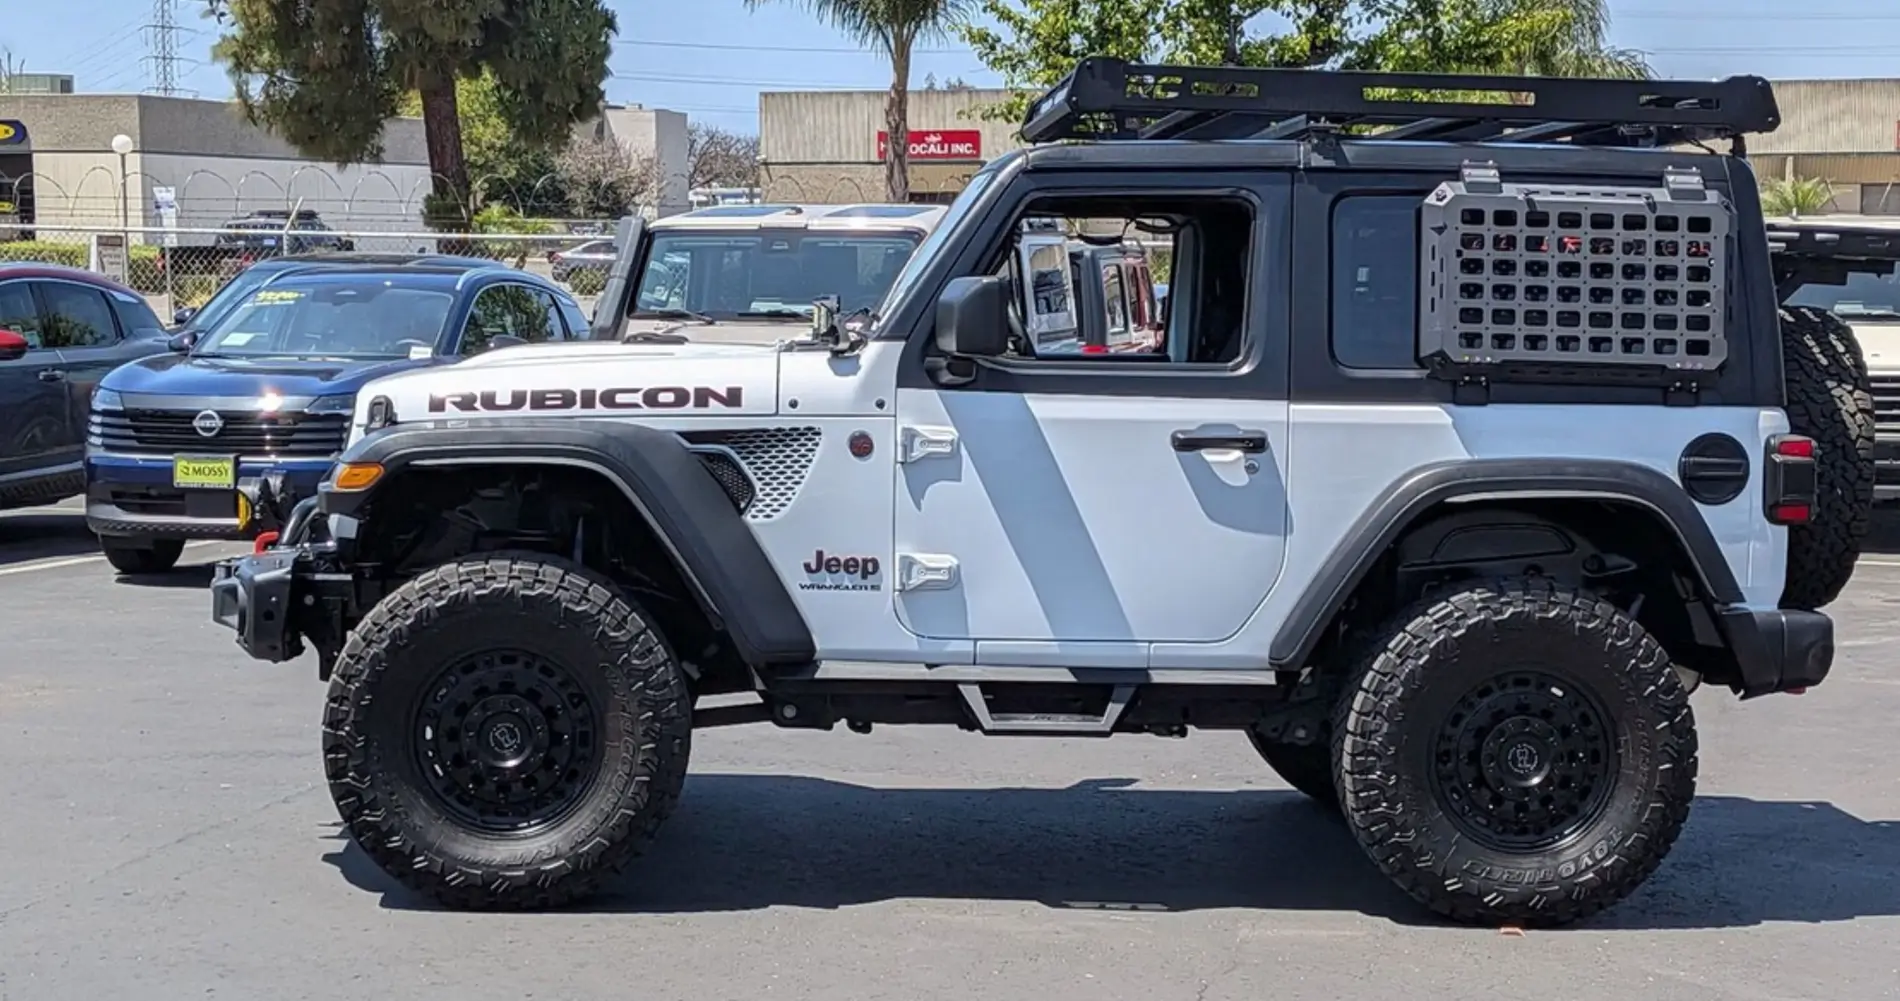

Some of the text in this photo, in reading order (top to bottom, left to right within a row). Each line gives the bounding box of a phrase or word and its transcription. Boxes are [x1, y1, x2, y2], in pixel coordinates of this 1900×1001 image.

[951, 143, 976, 154] INC.
[428, 387, 743, 412] RUBICON
[192, 465, 229, 477] MOSSY
[803, 550, 880, 580] Jeep
[1558, 827, 1622, 878] TOYO
